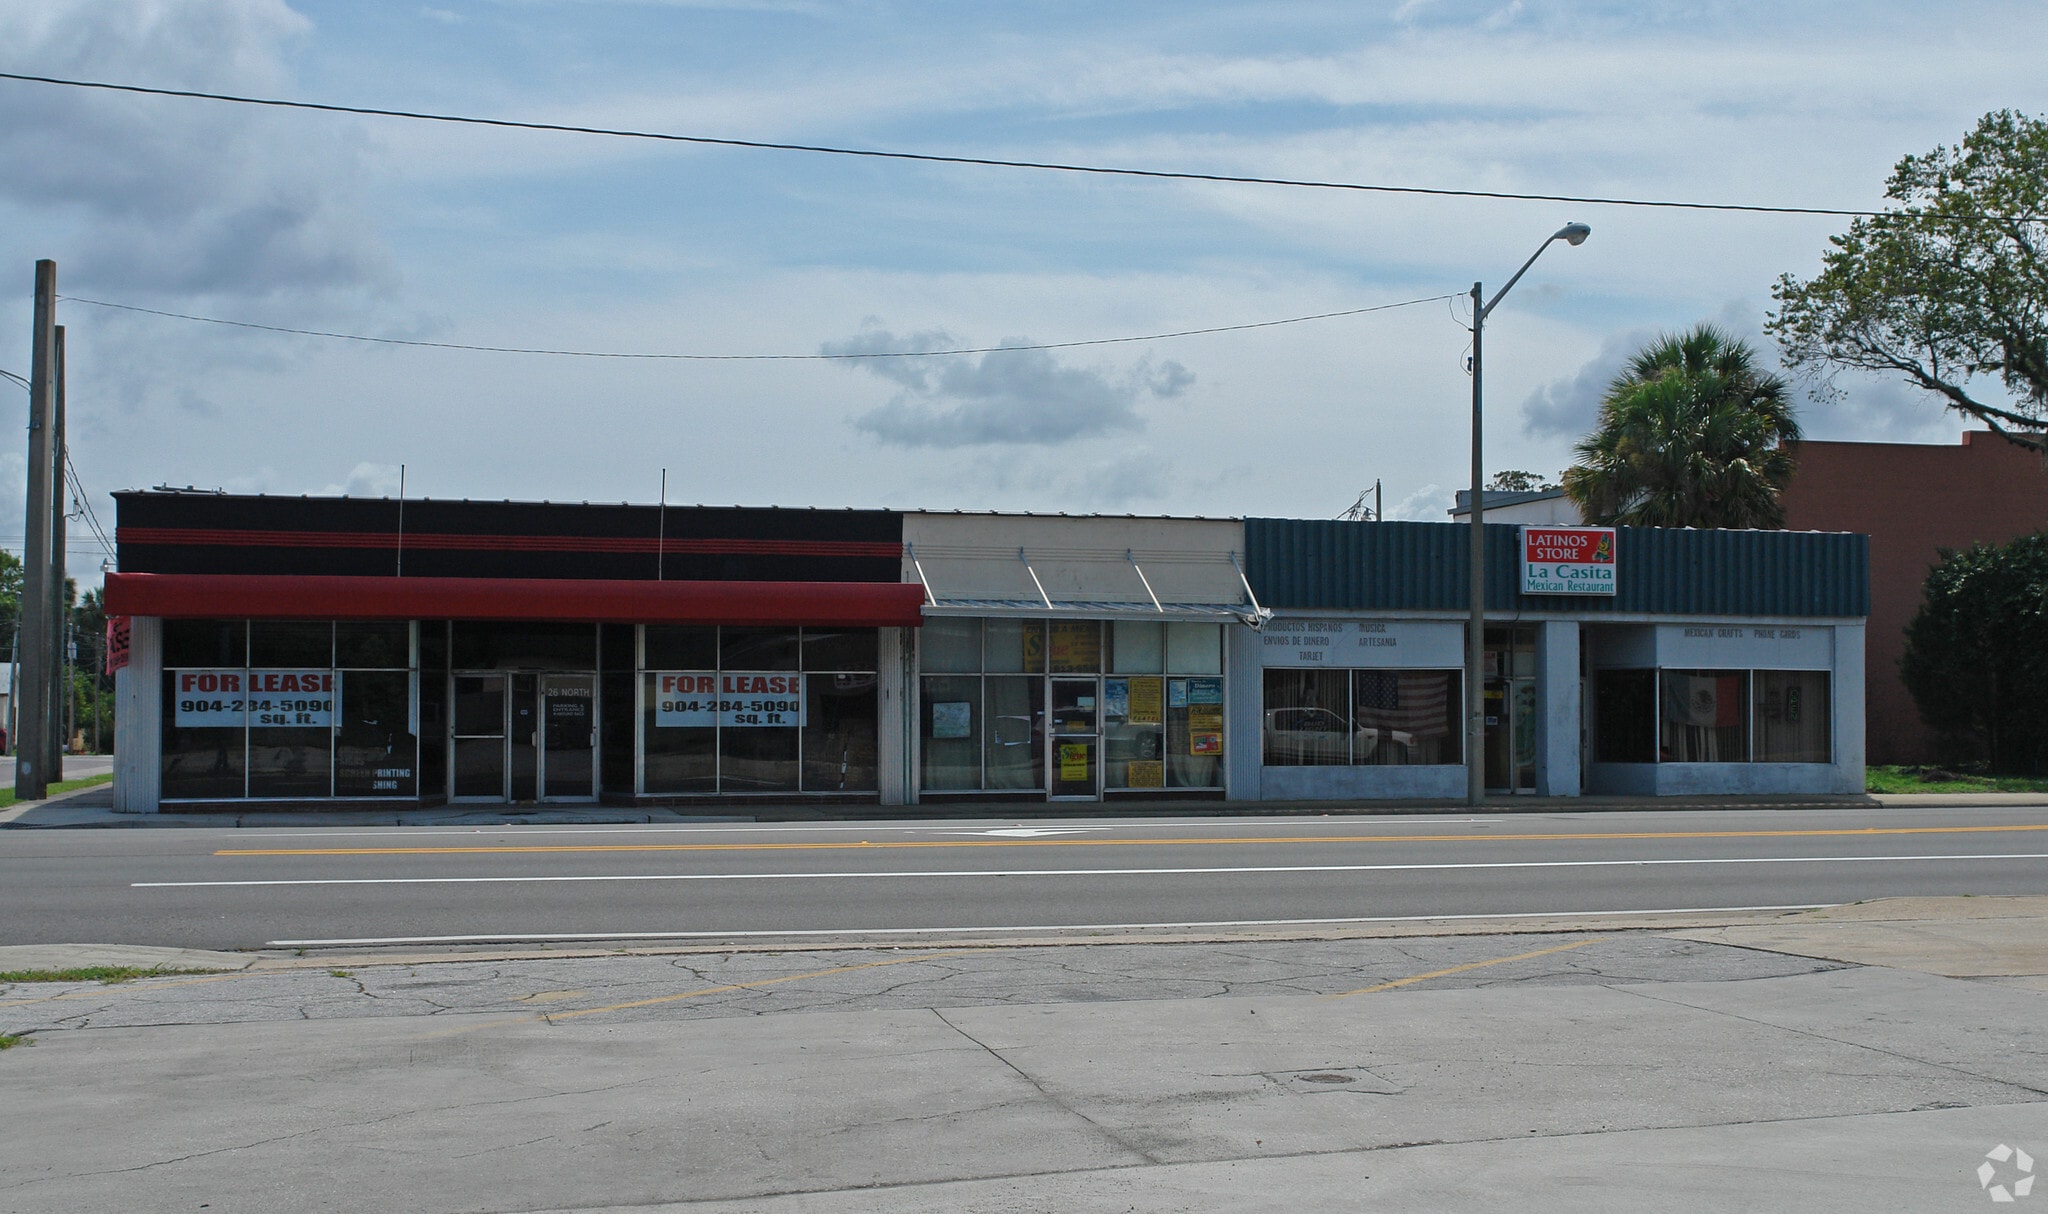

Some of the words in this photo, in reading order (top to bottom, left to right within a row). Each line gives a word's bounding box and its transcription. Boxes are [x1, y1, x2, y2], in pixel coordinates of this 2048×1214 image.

[1528, 534, 1588, 547] LATINOS
[1536, 548, 1579, 560] STORE
[1528, 564, 1548, 578] La
[1556, 564, 1612, 579] Casita
[1527, 579, 1564, 591] Mexican
[1568, 580, 1614, 592] Restaurant
[1263, 623, 1305, 633] PRODUCTOS
[1308, 623, 1343, 633] HISPANOS
[1358, 624, 1387, 633] MUSICA
[1684, 628, 1714, 638] MEXICAN
[1717, 628, 1744, 638] CRAFTS
[1753, 629, 1776, 639] PHONE
[1779, 629, 1802, 640] CARDS
[1263, 636, 1290, 646] ENVIOS
[1292, 637, 1301, 646] DE
[1303, 637, 1330, 647] DINERO
[1358, 637, 1398, 648] ARTESANIA
[1298, 651, 1324, 661] TARJET
[181, 674, 240, 693] FOR
[249, 674, 337, 693] LEASE
[662, 676, 715, 693] FOR
[722, 676, 799, 694] LEASE
[548, 688, 559, 697] 26
[561, 688, 590, 697] NORTH
[662, 700, 799, 713] 904-284-5090
[260, 713, 291, 724] sq.
[296, 713, 317, 724] ft.
[735, 714, 763, 725] sq.
[766, 713, 786, 724] ft.
